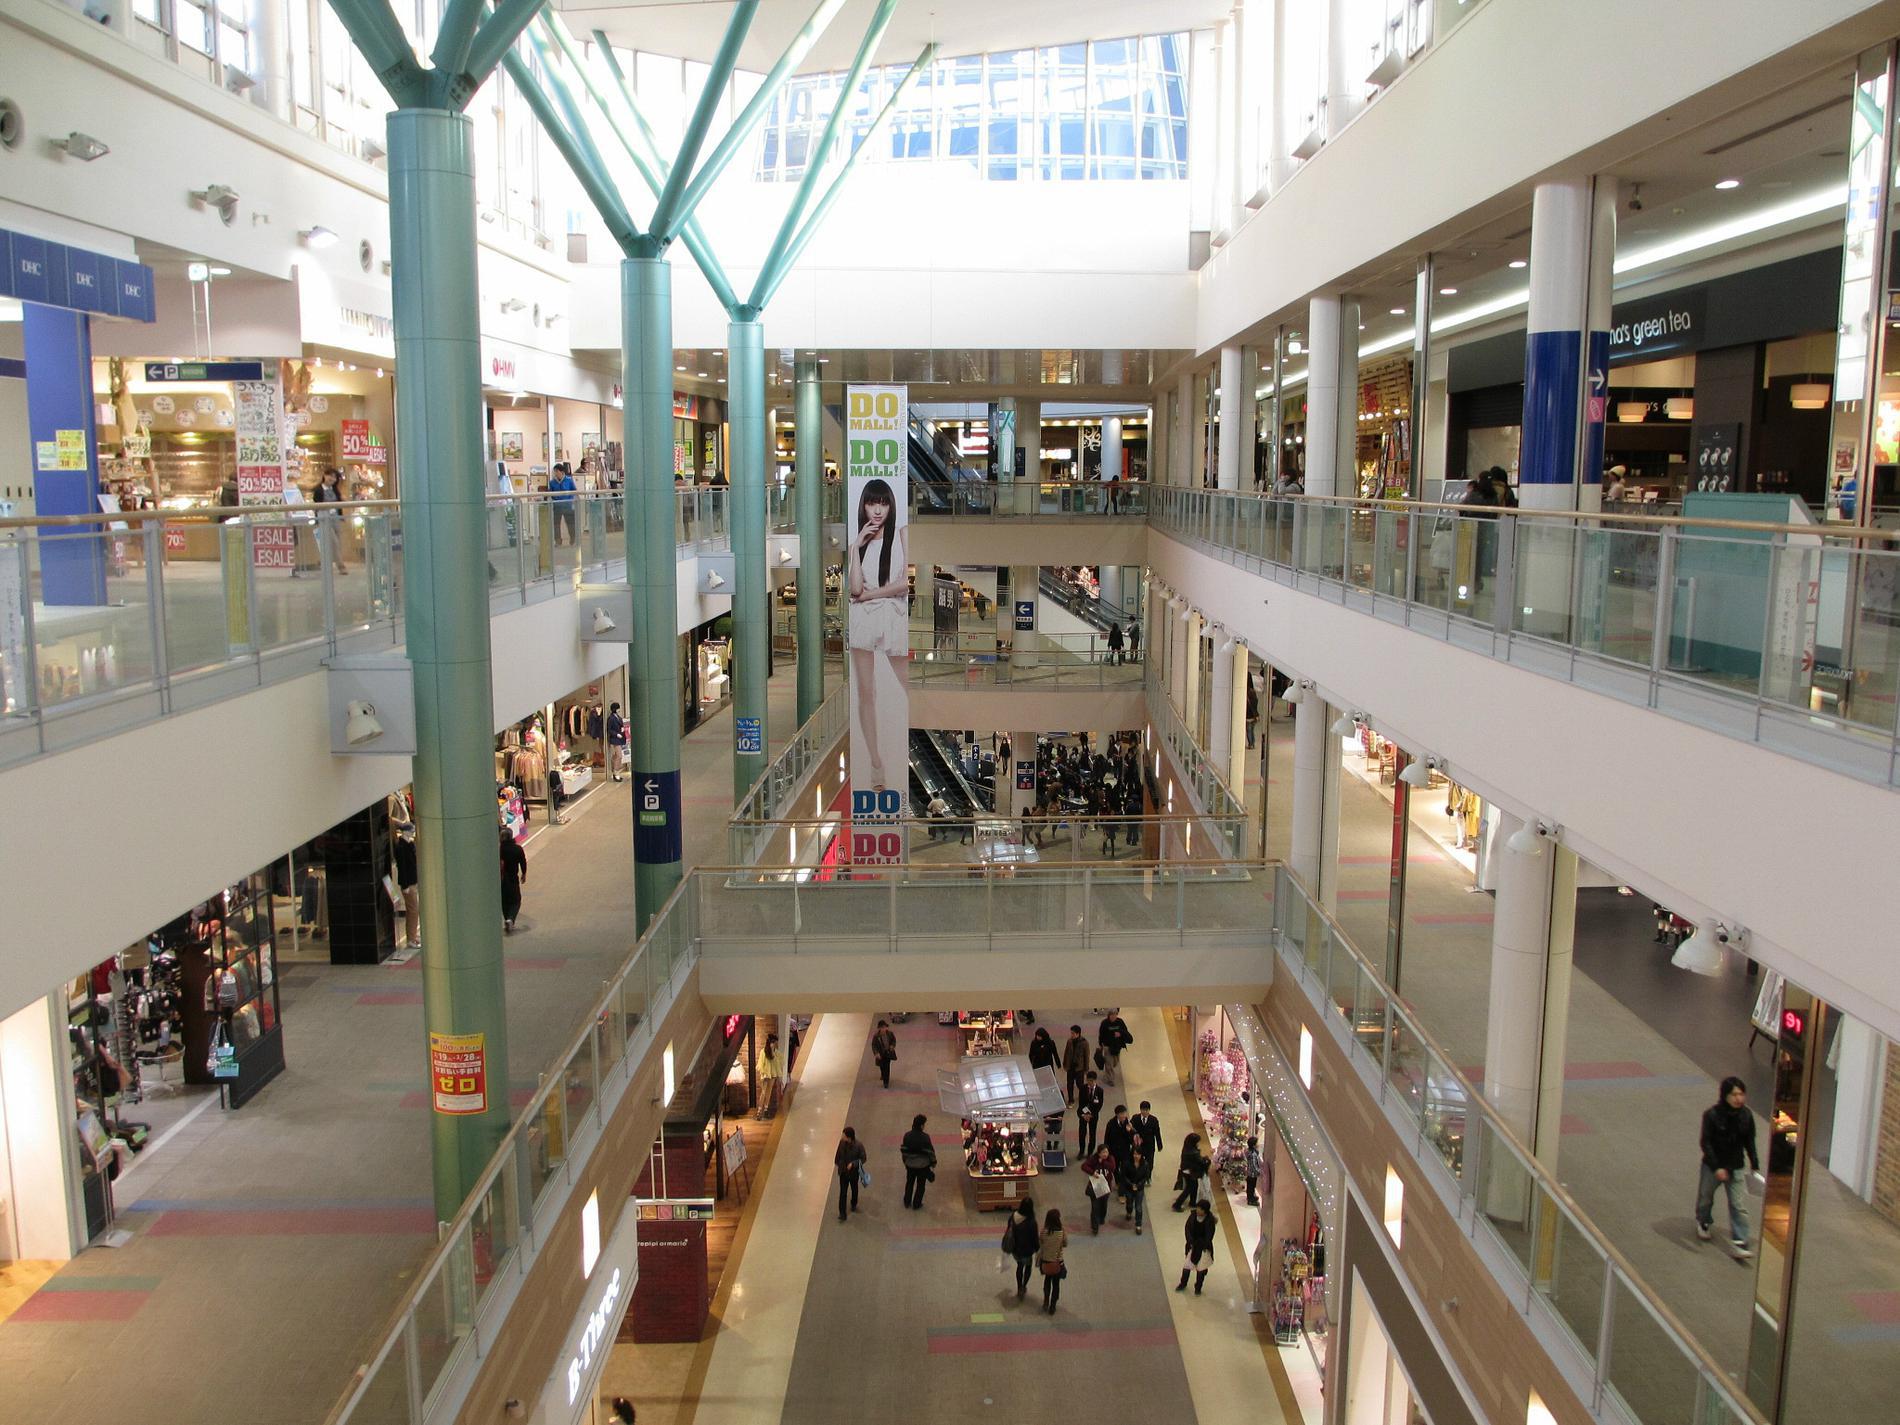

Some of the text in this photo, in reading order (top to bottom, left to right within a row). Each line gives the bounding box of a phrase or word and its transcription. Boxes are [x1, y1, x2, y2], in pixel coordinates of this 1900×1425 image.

[22, 260, 41, 276] DHC
[76, 272, 94, 287] DHC
[125, 284, 141, 297] DHC
[1632, 316, 1667, 345] green
[1669, 310, 1691, 333] tea
[499, 360, 515, 378] HMV
[850, 393, 898, 418] DO
[850, 419, 898, 430] MALL!
[850, 440, 898, 464] DO
[850, 466, 898, 477] MALL!
[648, 798, 656, 807] P
[853, 790, 900, 813] DO
[854, 833, 900, 857] DO
[439, 1077, 476, 1092] ゼロ
